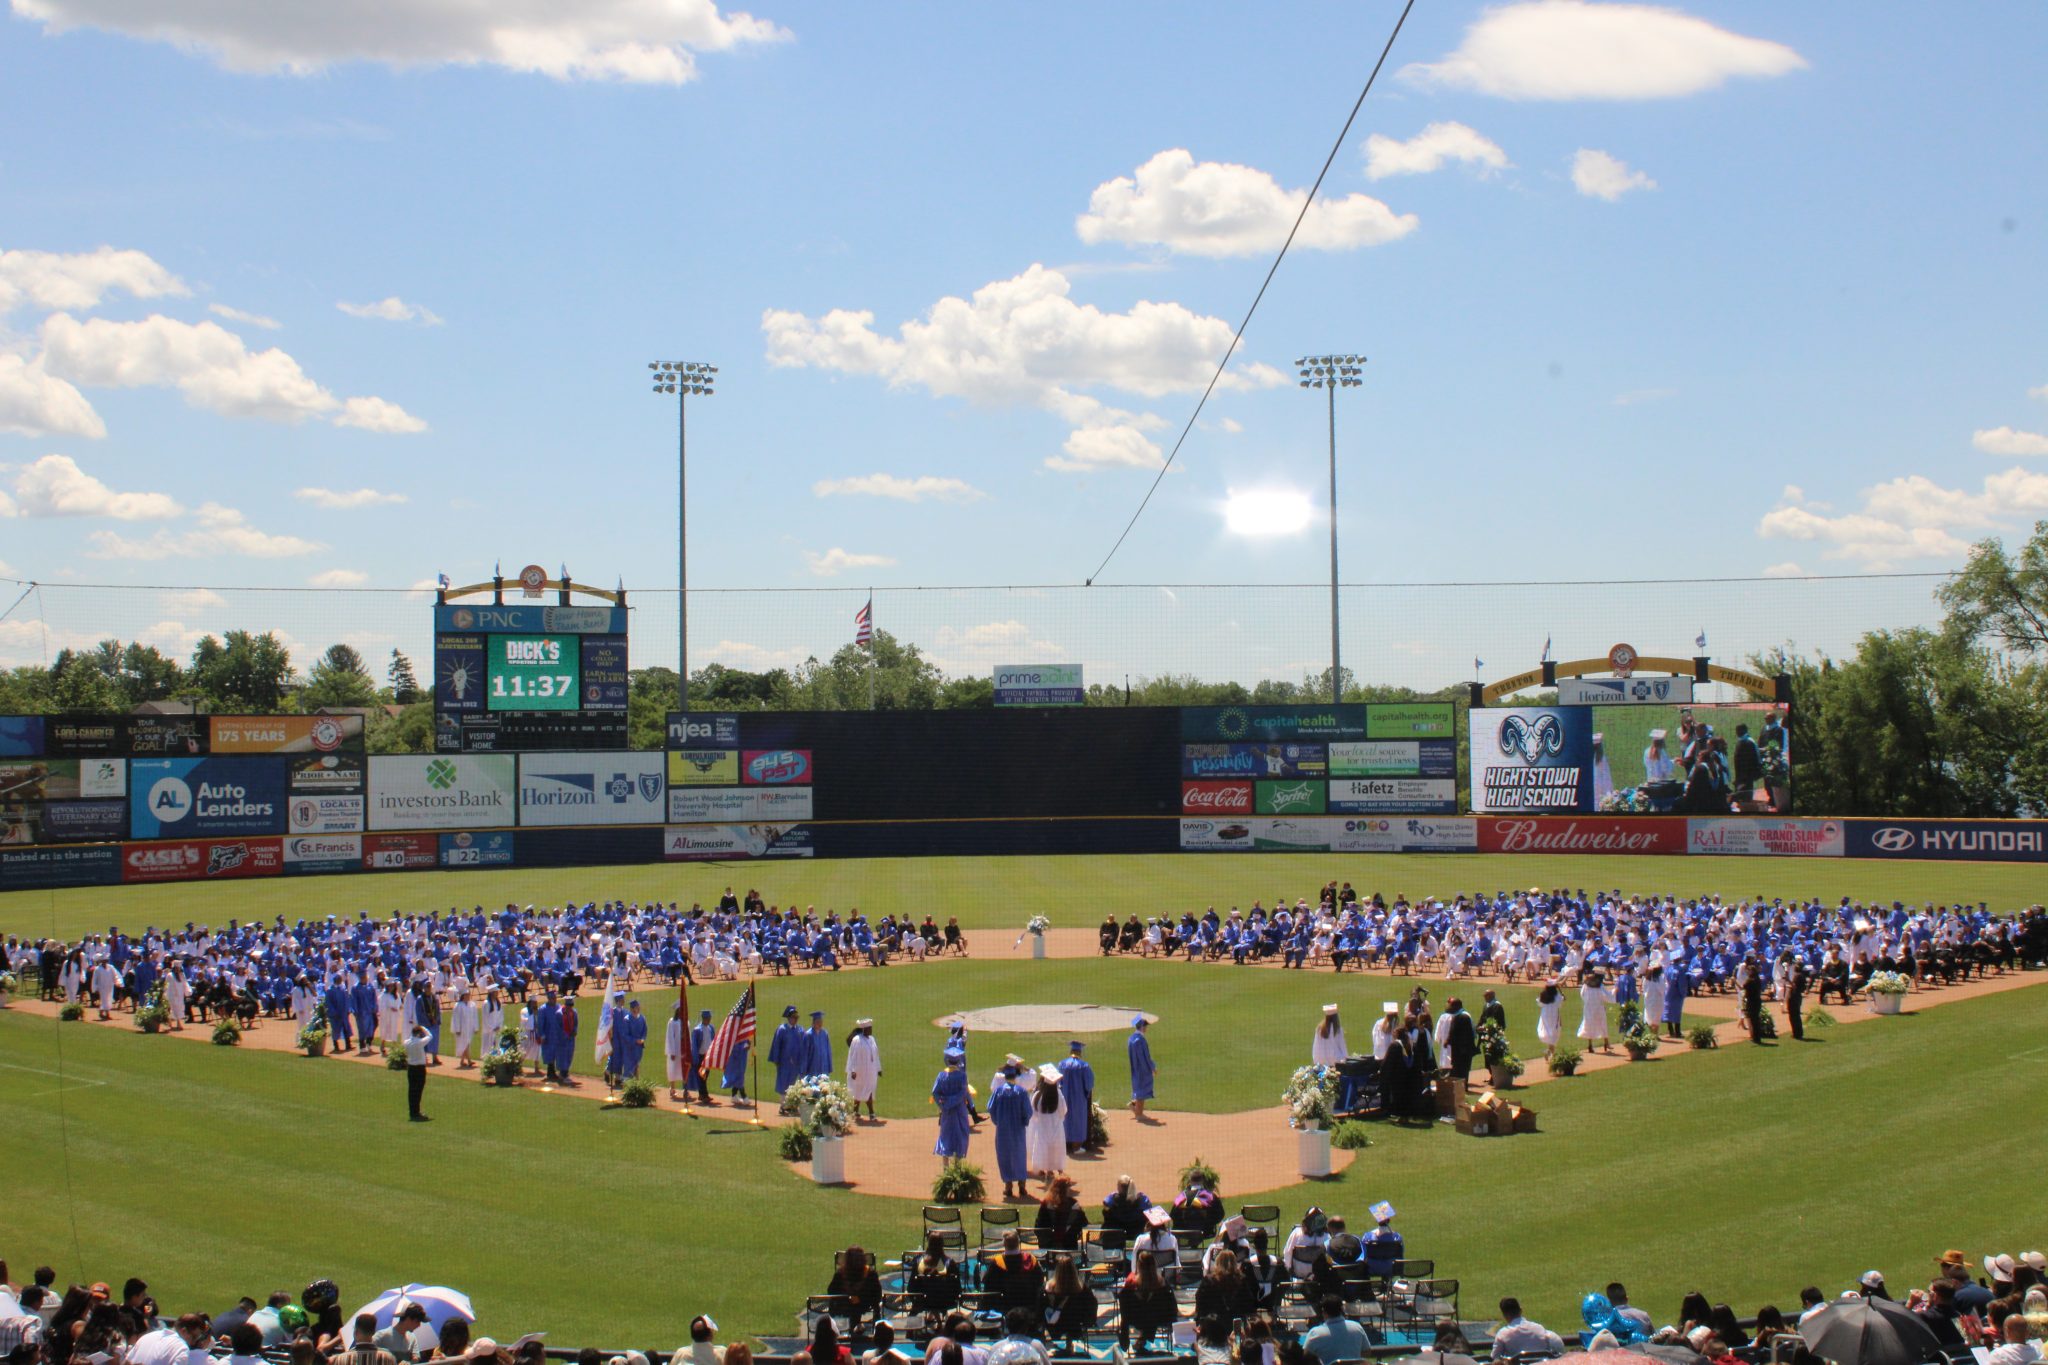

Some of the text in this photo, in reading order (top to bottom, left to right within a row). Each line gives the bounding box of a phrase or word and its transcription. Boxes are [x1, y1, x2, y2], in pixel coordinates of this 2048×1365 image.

[478, 611, 522, 628] PNC
[506, 639, 560, 660] DICK'S
[492, 675, 573, 697] 11:37
[999, 671, 1073, 688] primepoint
[1492, 674, 1535, 696] TRENTON
[1719, 669, 1765, 691] THUNDER
[1579, 690, 1626, 702] Horizon
[137, 719, 155, 727] YOUR
[1254, 713, 1336, 730] capitalhealth
[1372, 711, 1449, 722] capitalhealth.org
[217, 729, 286, 742] 175 YEARS
[468, 732, 496, 740] VISITOR
[669, 717, 712, 743] njea
[471, 741, 494, 750] HOME
[1331, 748, 1351, 757] Your
[1352, 744, 1378, 756] local
[1378, 748, 1407, 756] source
[1347, 756, 1392, 765] for trusted
[1485, 766, 1580, 788] HIGHTSTOWN
[197, 782, 246, 799] Auto
[1351, 781, 1394, 794] Hafetz
[156, 790, 185, 809] AL
[521, 787, 597, 806] Horizon
[673, 793, 754, 802] Robert Wood Johnson
[1183, 787, 1250, 807] Coca-Cola
[1273, 791, 1309, 803] Sprite
[1485, 787, 1579, 808] HIGH SCHOOL
[51, 806, 123, 814] REVOLUTIONIZING
[196, 800, 273, 817] Lenders
[320, 801, 349, 809] LOCAL
[673, 801, 743, 811] University Hospital
[51, 813, 100, 821] VETERINARY
[1784, 822, 1797, 830] The
[1495, 819, 1659, 851] Budweiser
[1759, 829, 1825, 842] GRAND SLAM
[1922, 830, 2043, 852] HYUNDAI
[301, 842, 355, 853] St. Francis
[1770, 842, 1818, 854] IMAGING!
[2, 852, 38, 862] Ranked
[64, 849, 80, 859] the
[82, 849, 113, 859] nation
[128, 844, 200, 867] CASE'S
[366, 853, 404, 865] $ 40
[442, 850, 480, 862] $ 22
